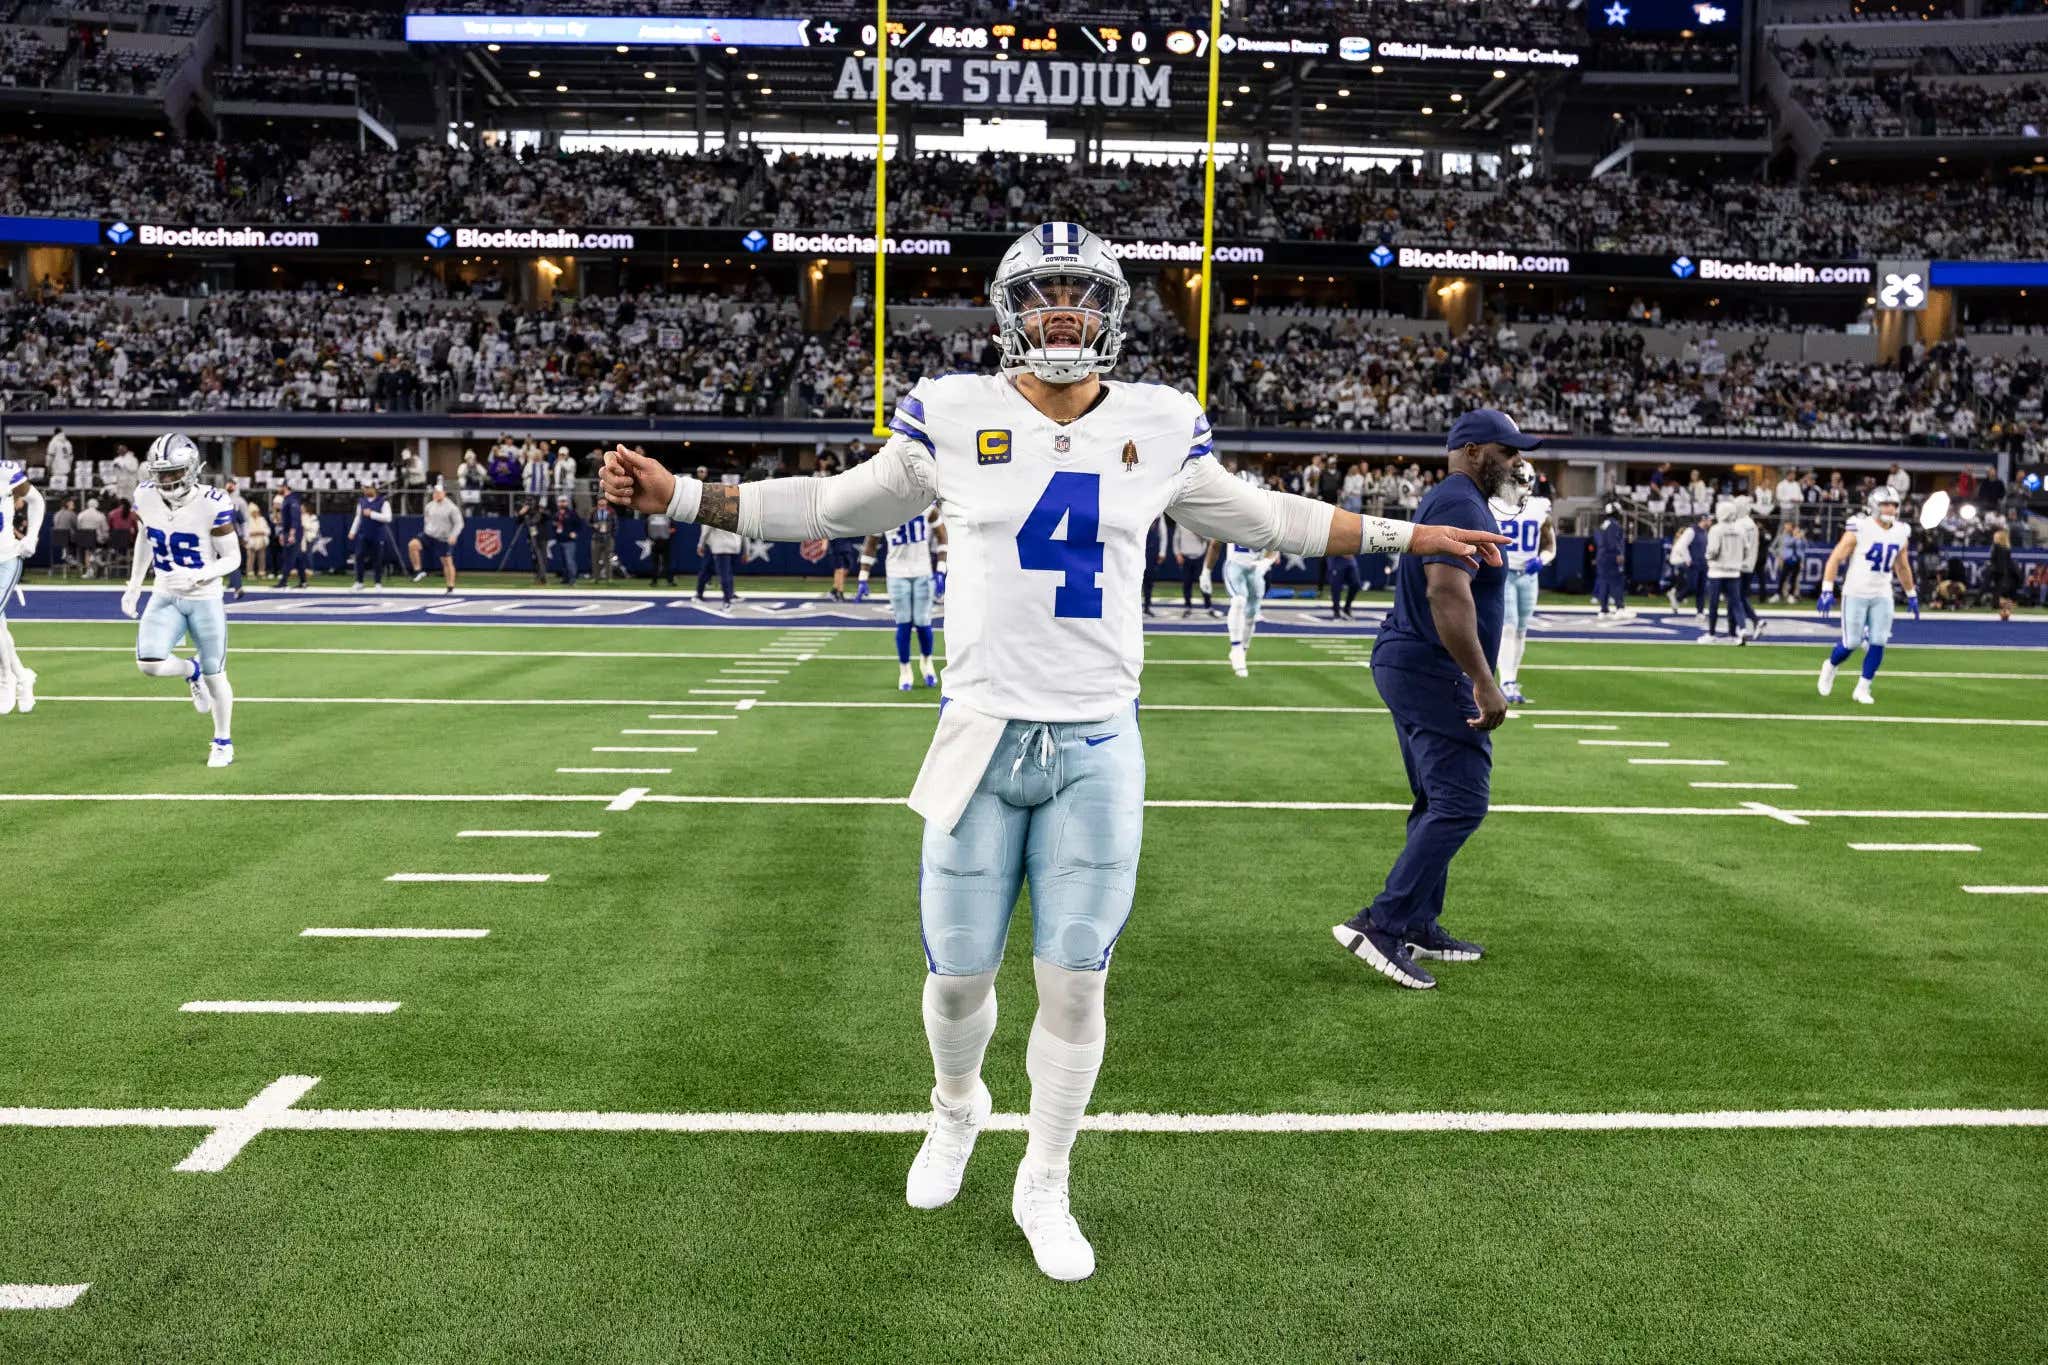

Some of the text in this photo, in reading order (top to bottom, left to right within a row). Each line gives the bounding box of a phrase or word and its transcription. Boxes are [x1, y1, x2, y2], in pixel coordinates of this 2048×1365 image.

[861, 24, 877, 45] 0
[890, 33, 900, 46] 3
[928, 27, 988, 48] 45:06
[1000, 36, 1009, 49] 1
[1106, 39, 1118, 52] 3
[1131, 31, 1147, 52] 0
[1378, 42, 1421, 58] Official
[1421, 43, 1461, 60] Jeweler
[1461, 46, 1475, 59] of
[1475, 46, 1494, 60] the
[1494, 47, 1528, 62] Dallas
[1528, 49, 1579, 67] Cowboys
[834, 56, 1172, 108] AT&T STADIUM
[139, 225, 319, 247] Blockchain.com
[456, 229, 634, 249] Blockchain.com
[1398, 248, 1570, 273] Blockchain.com
[1699, 259, 1871, 283] Blockchain.com
[979, 431, 1009, 455] C
[892, 514, 925, 546] 30
[1500, 520, 1538, 552] 20
[146, 526, 205, 572] 26
[1016, 471, 1105, 619] 4
[1865, 543, 1900, 573] 40
